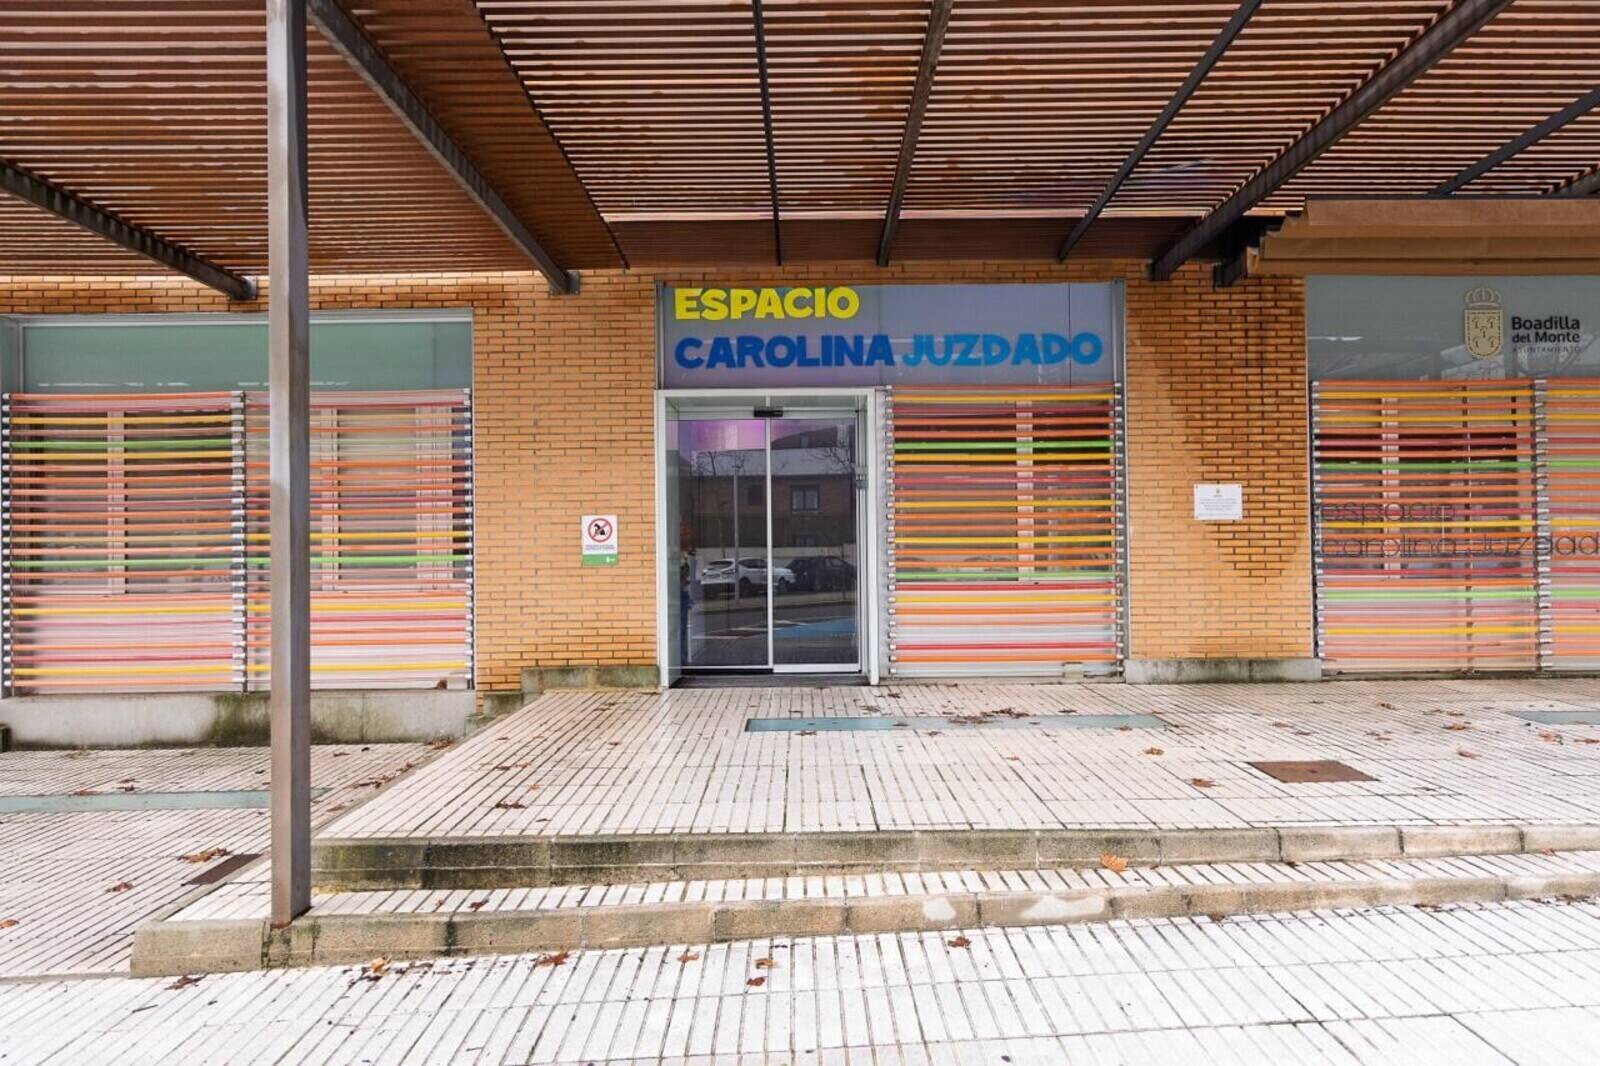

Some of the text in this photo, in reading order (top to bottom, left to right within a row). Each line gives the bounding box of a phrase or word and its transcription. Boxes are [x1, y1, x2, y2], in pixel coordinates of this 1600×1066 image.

[674, 286, 860, 321] ESPACIO
[1511, 315, 1580, 331] Boadilla
[674, 331, 1104, 369] CAROLINA JUZDADO
[1511, 331, 1580, 344] del Monte
